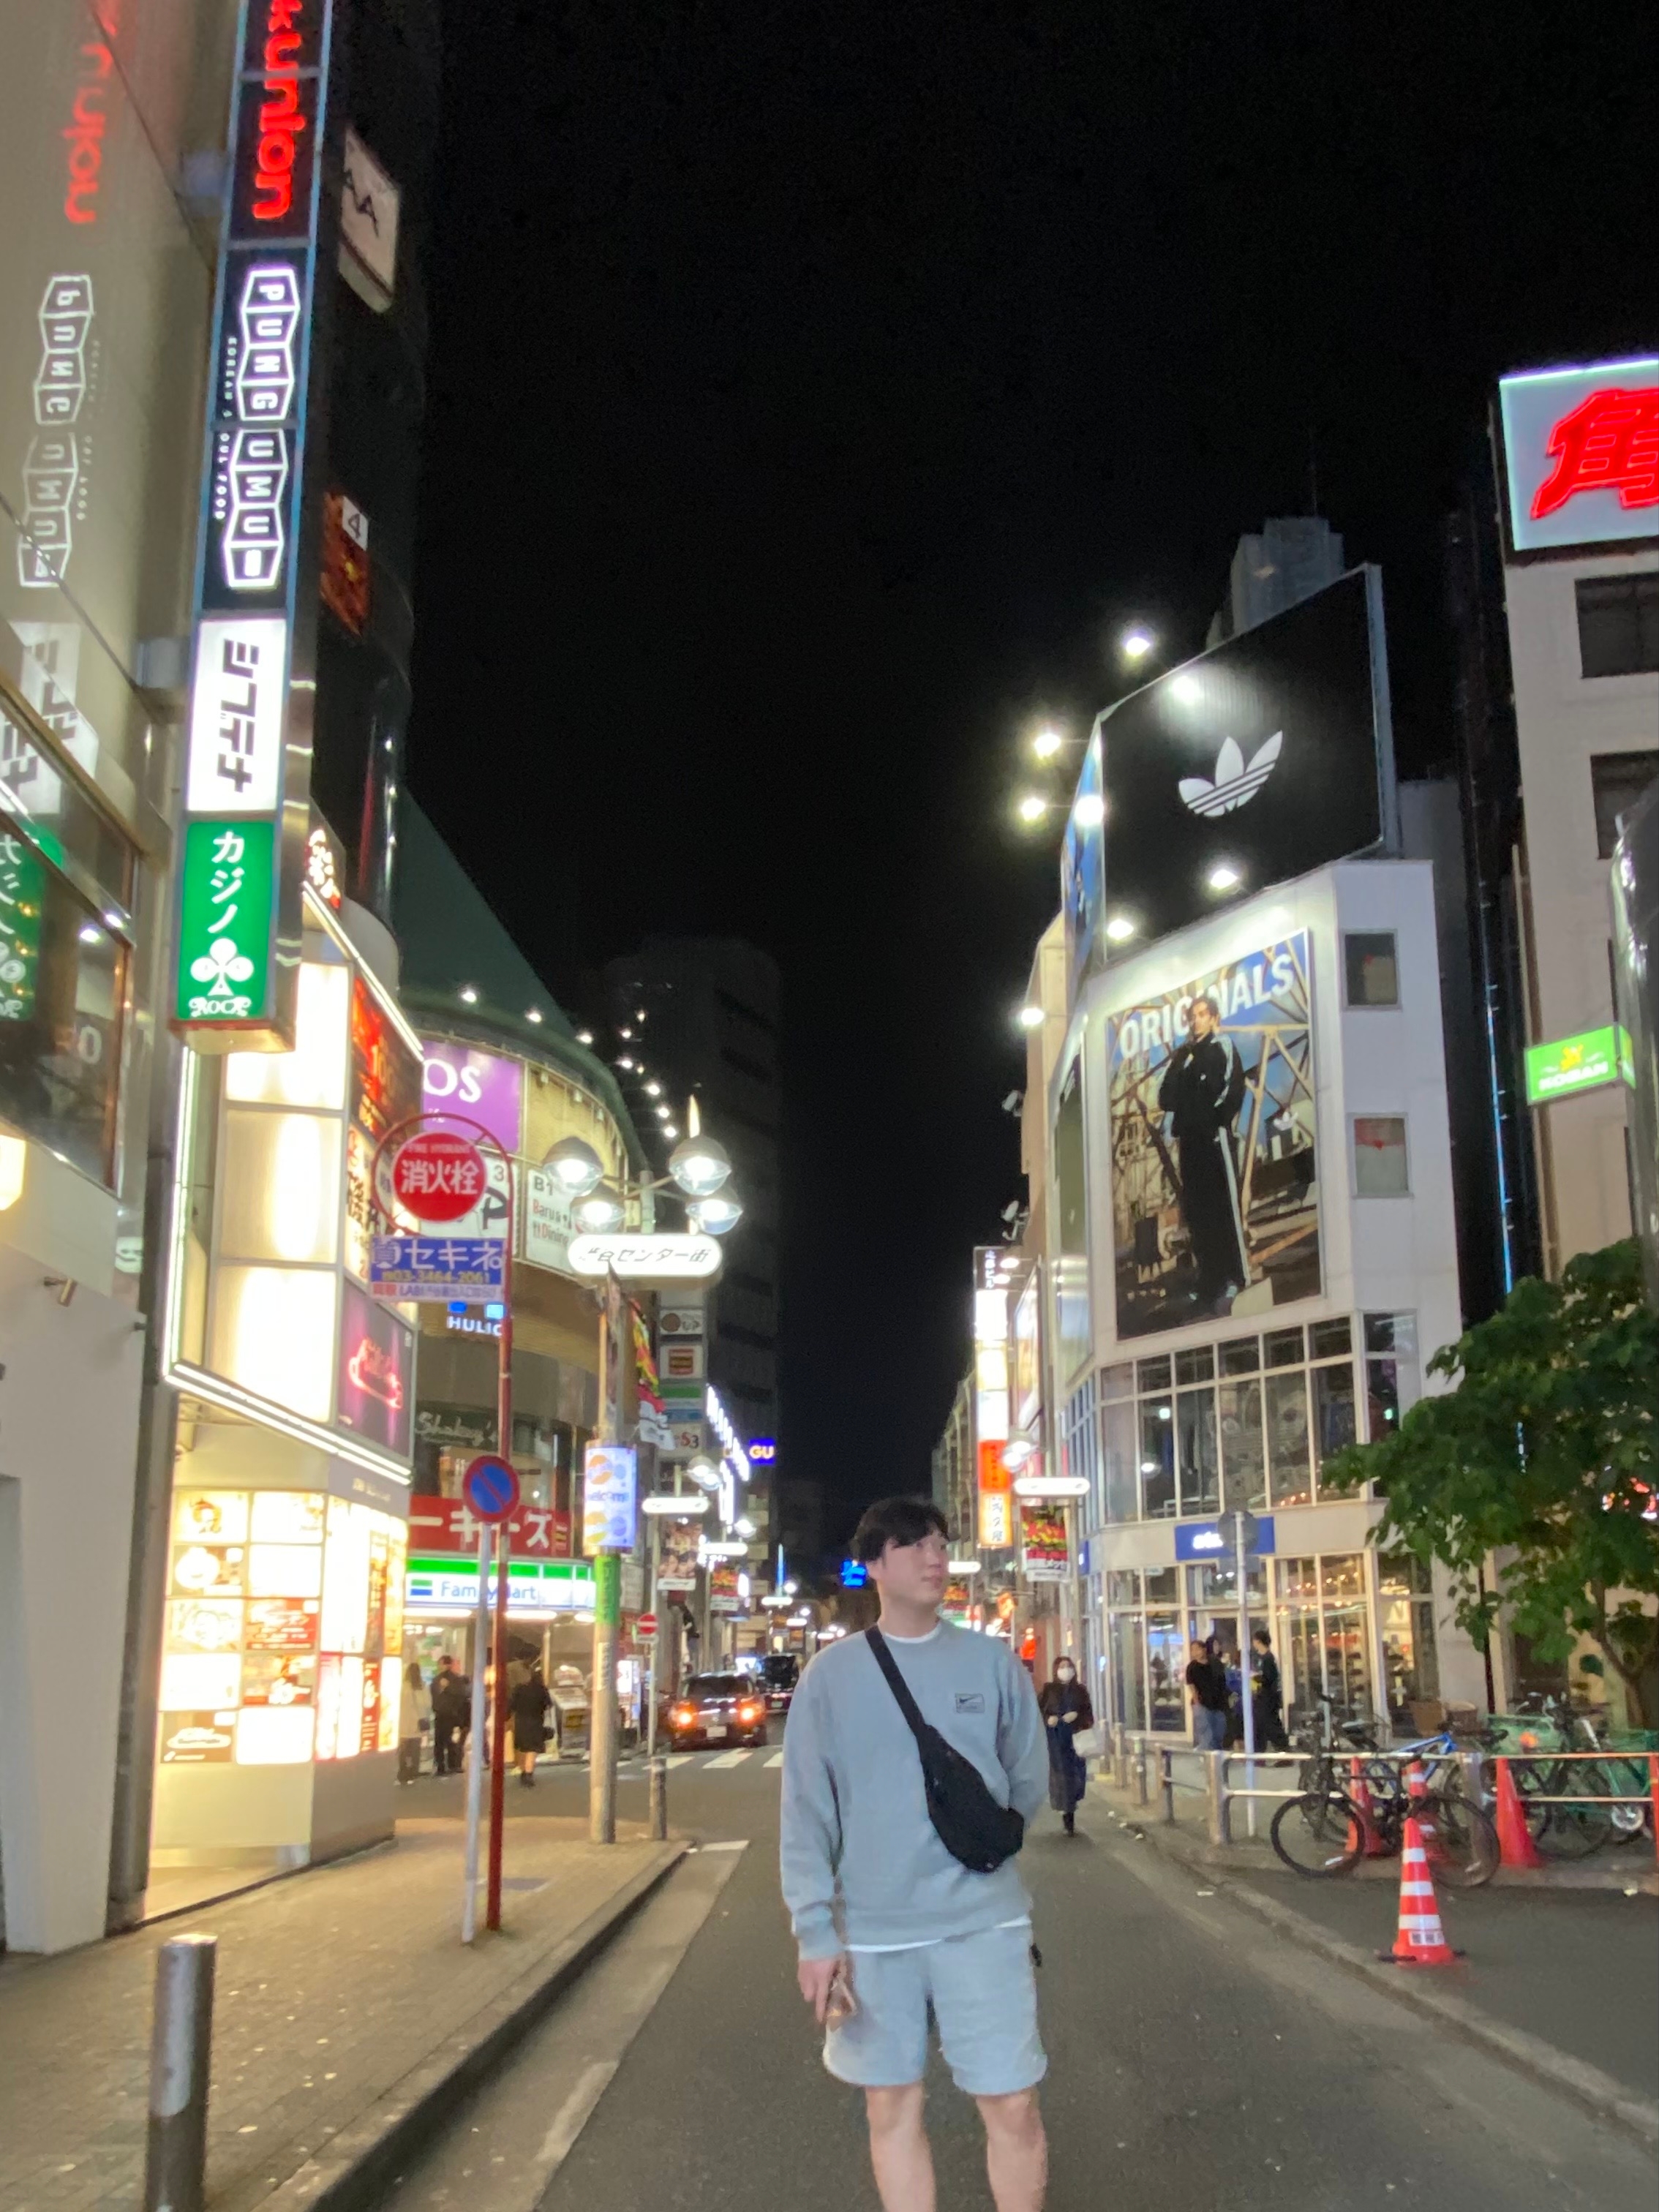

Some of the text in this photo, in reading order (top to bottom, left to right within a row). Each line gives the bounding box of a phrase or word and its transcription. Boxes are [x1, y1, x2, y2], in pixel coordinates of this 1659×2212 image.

[207, 831, 246, 934] カジノ
[401, 1159, 480, 1195] 消火栓
[534, 1175, 553, 1196] B1
[749, 1445, 775, 1459] GU
